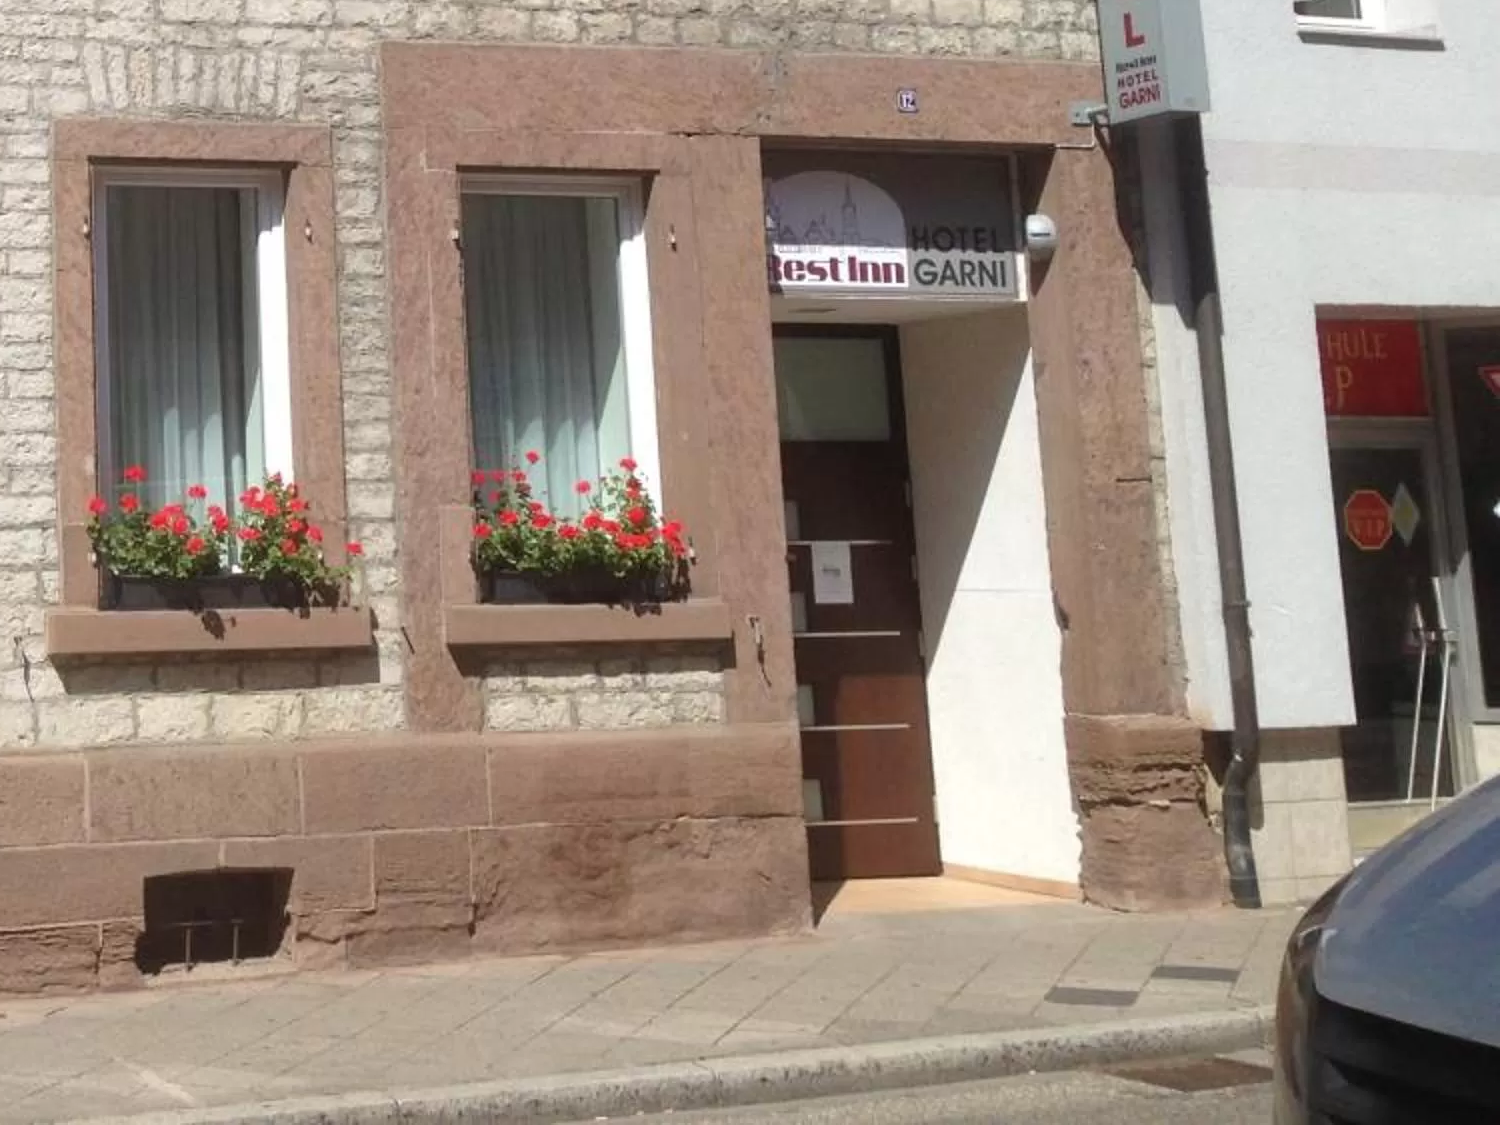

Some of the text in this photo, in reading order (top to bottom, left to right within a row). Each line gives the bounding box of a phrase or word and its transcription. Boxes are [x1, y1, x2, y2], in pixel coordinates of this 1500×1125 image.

[1117, 68, 1159, 88] HOTEL
[1119, 83, 1161, 108] GARNI
[912, 226, 1005, 254] HOTEL
[848, 254, 905, 283] Inn
[913, 258, 1007, 288] GARNI
